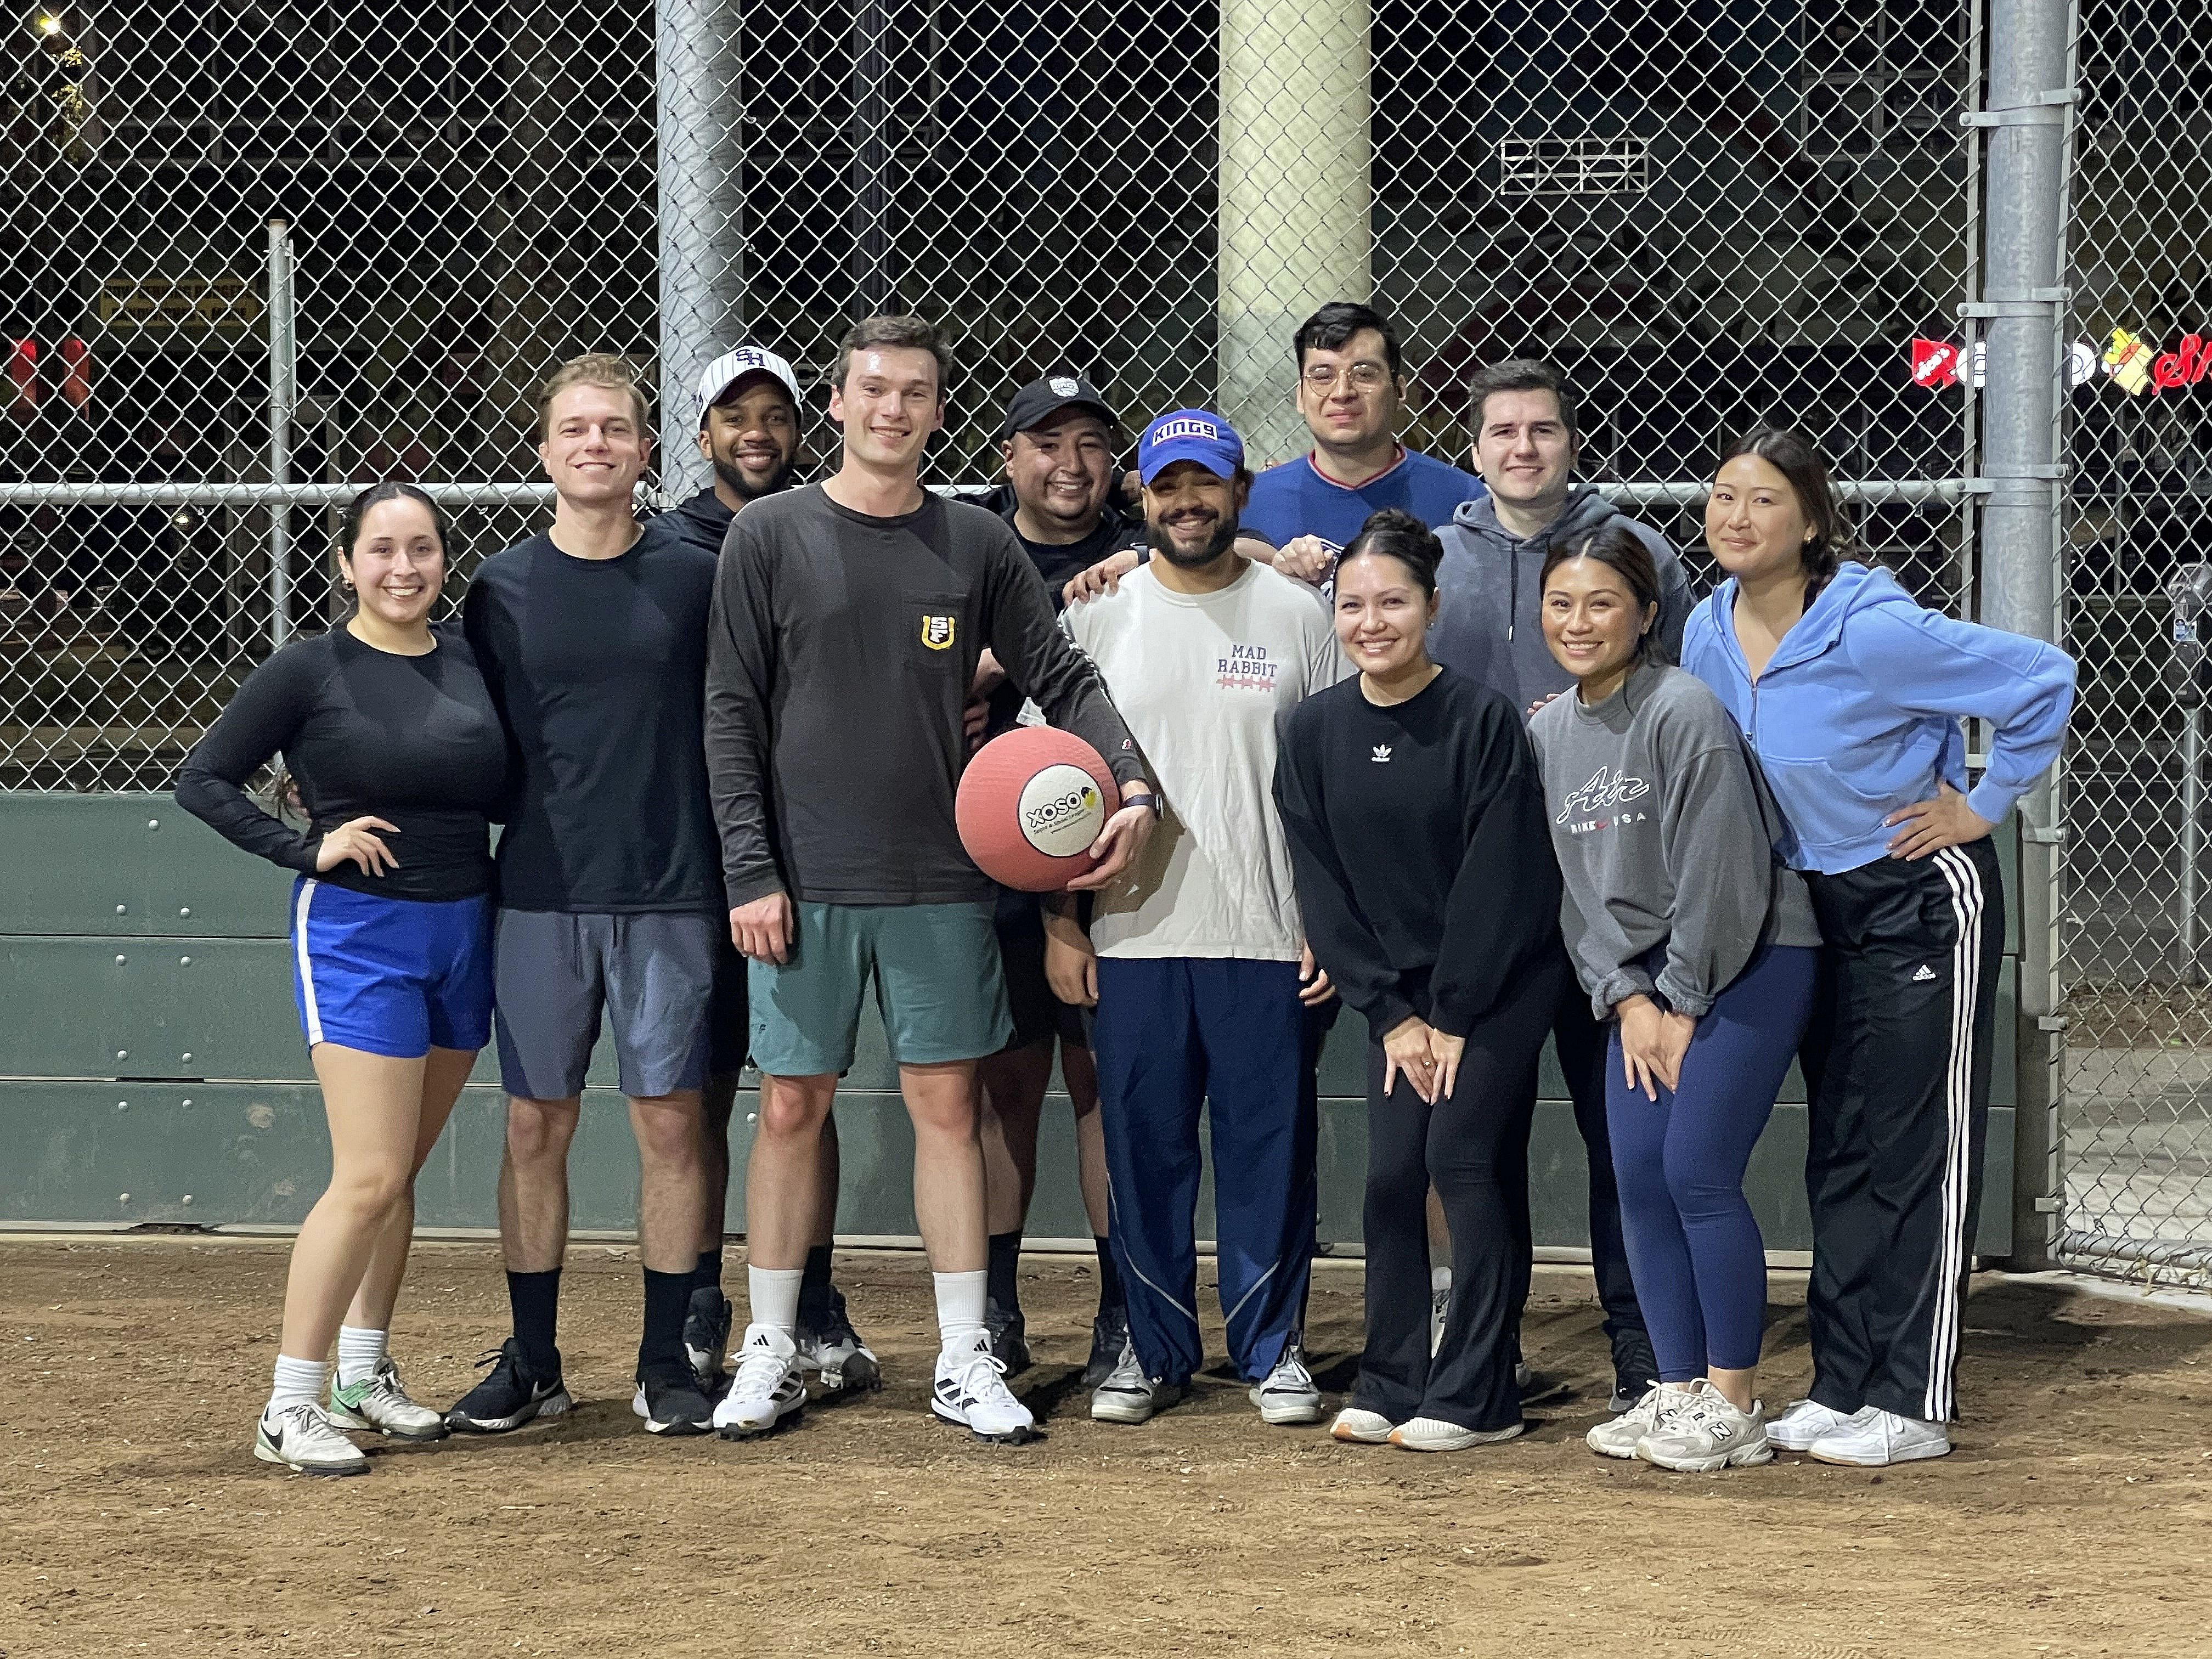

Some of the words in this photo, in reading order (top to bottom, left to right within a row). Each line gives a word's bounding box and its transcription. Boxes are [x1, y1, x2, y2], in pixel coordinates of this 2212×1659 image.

[1155, 421, 1215, 442] KINGS
[1232, 644, 1267, 660] MAD
[1217, 658, 1278, 678] RABBIT
[1026, 792, 1082, 828] XOSO
[1708, 1421, 1733, 1441] N
